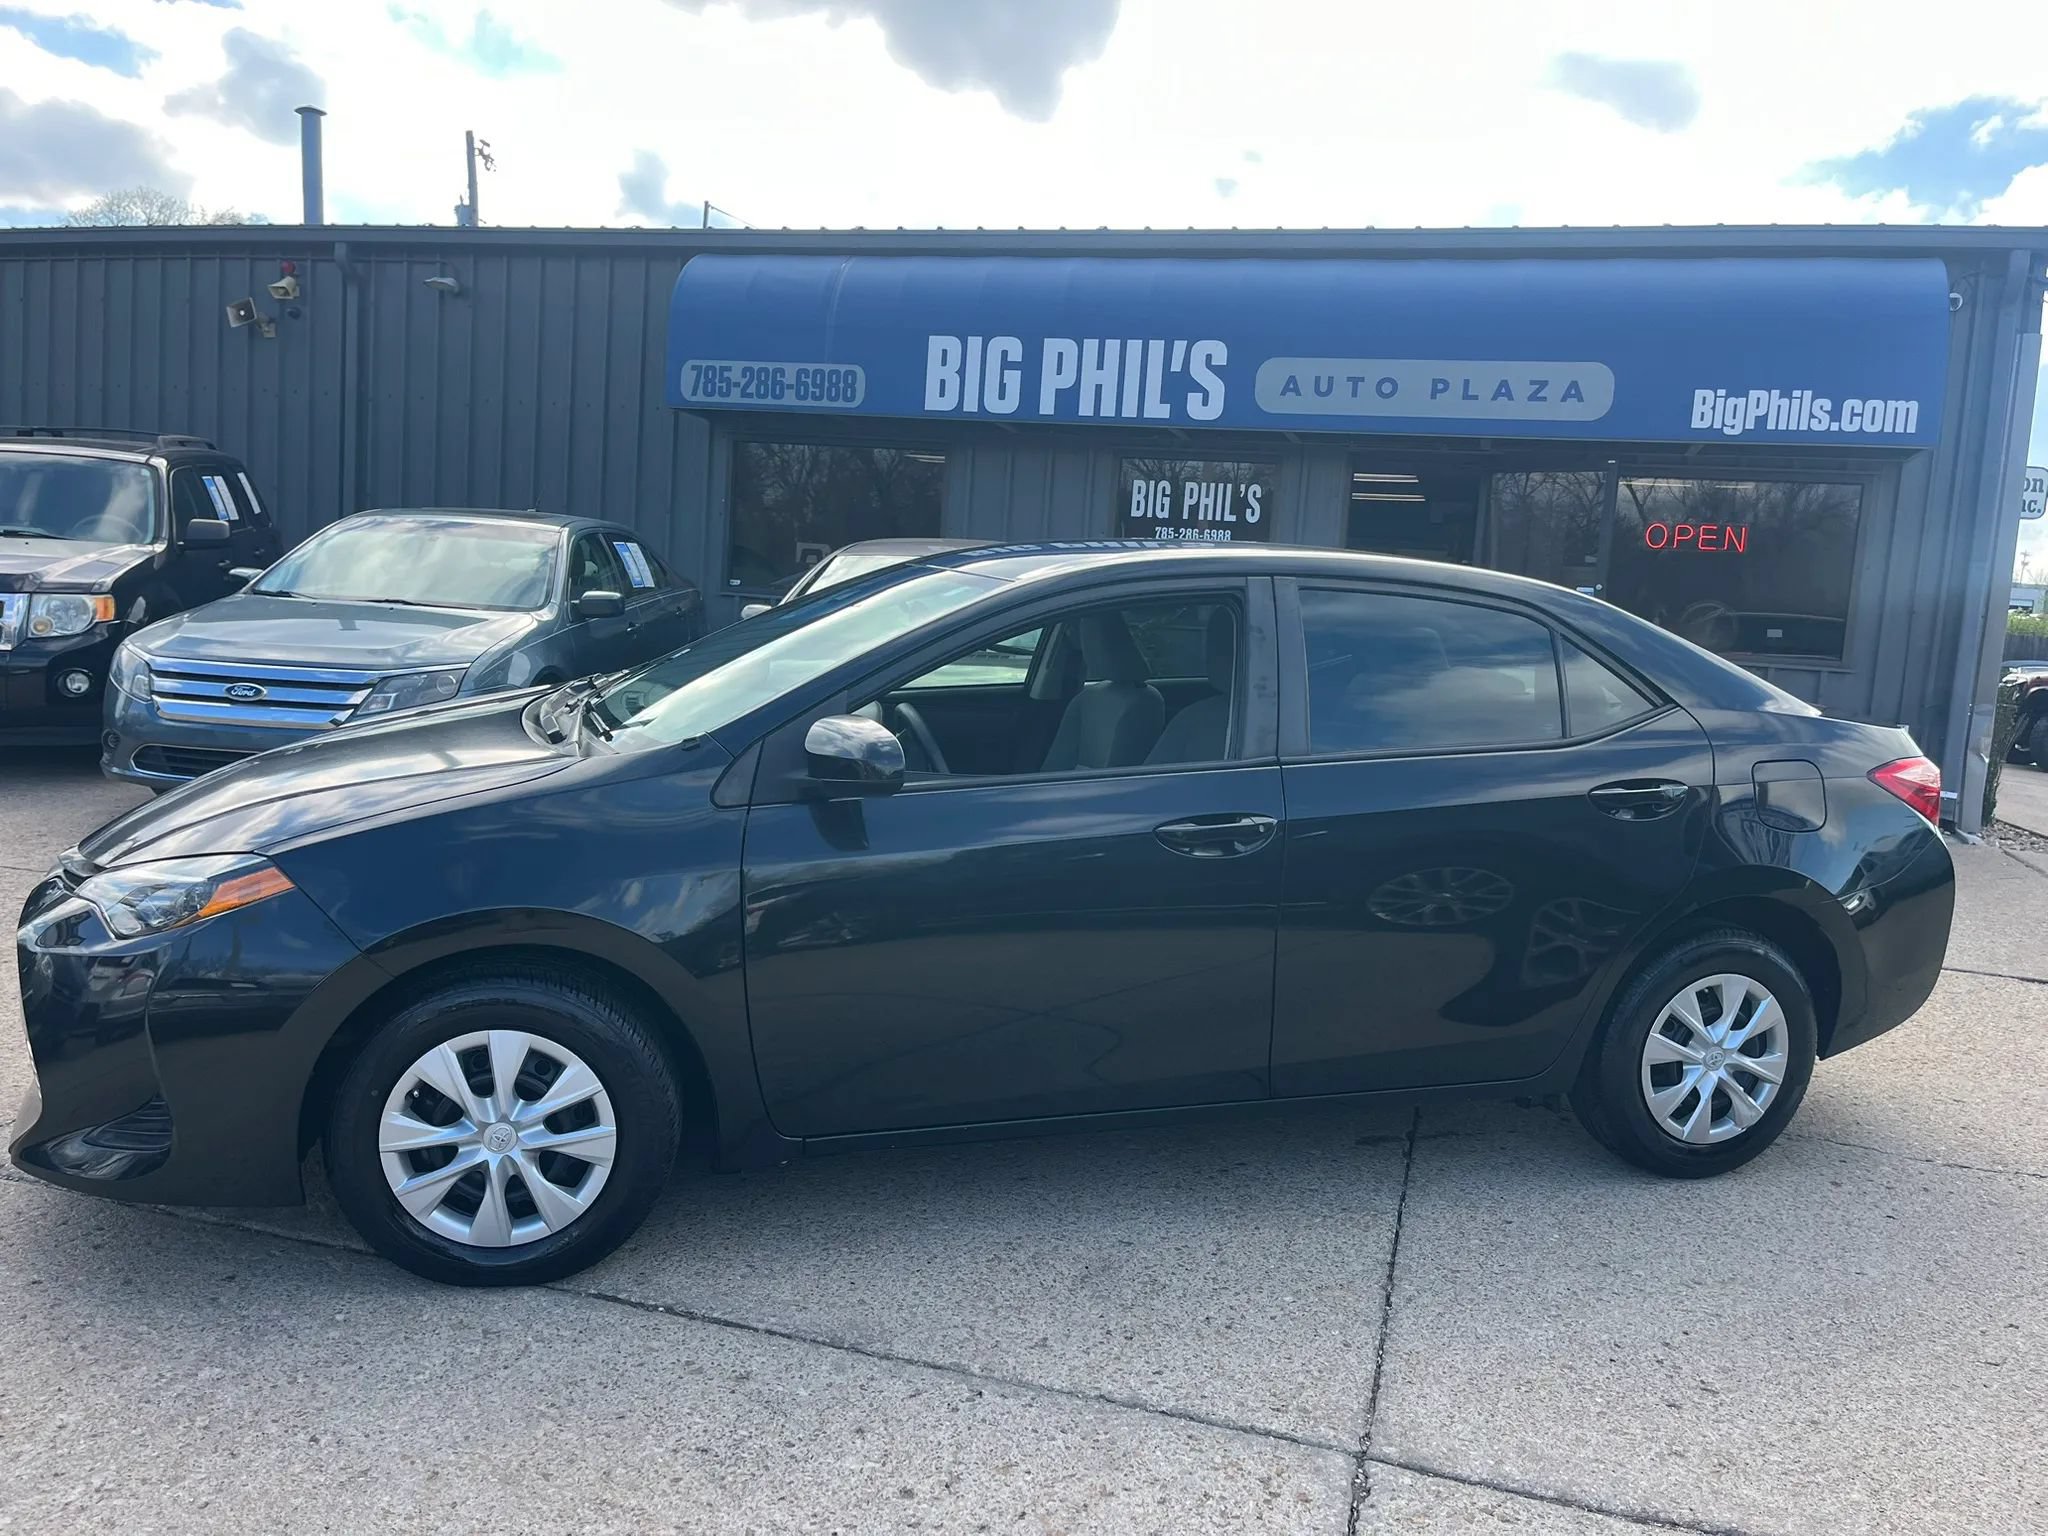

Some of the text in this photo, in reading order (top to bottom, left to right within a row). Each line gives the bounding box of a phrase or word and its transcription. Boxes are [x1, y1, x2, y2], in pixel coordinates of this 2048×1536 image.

[690, 364, 857, 402] 785-286-6988
[924, 335, 1228, 420] BIG PHIL'S
[1280, 375, 1585, 402] AUTO PLAZA
[1691, 389, 1918, 435] BigPhils.com
[1131, 480, 1262, 523] BIG PHIL'S
[1155, 526, 1231, 541] 785-286-6988
[1645, 522, 1748, 553] OPEN
[231, 685, 256, 697] Ford
